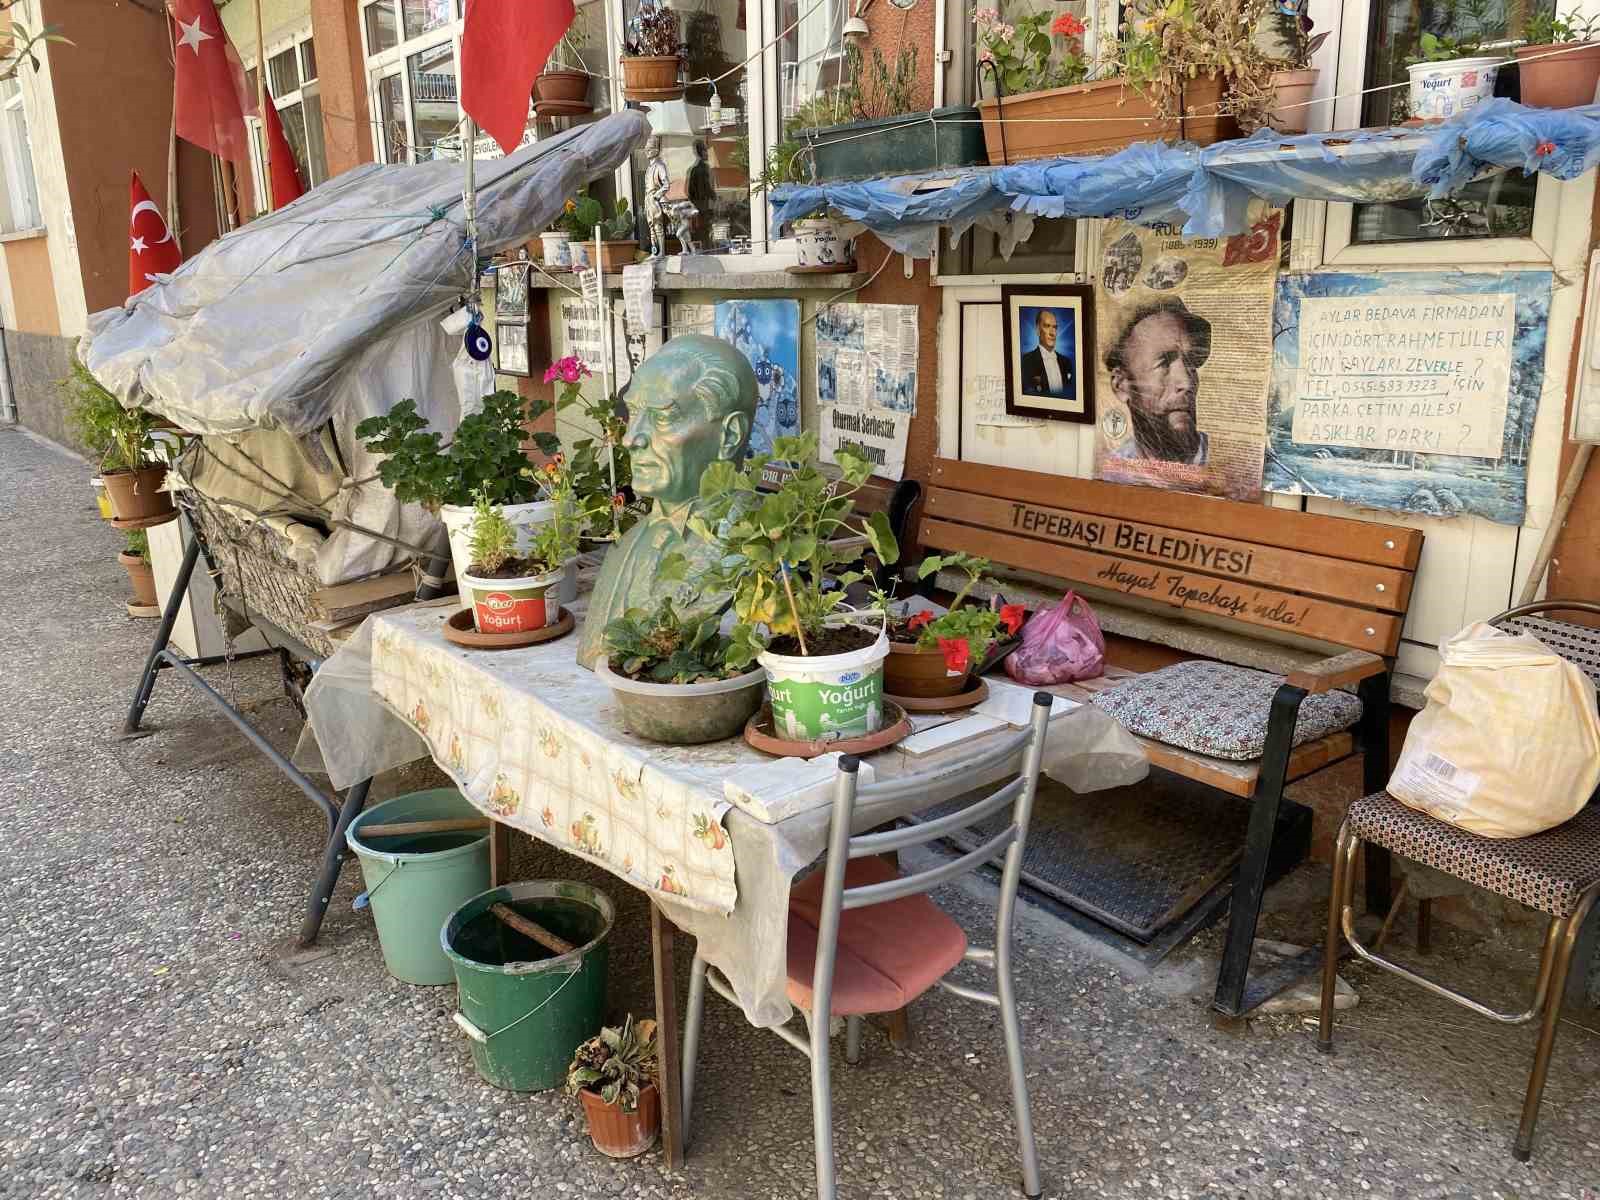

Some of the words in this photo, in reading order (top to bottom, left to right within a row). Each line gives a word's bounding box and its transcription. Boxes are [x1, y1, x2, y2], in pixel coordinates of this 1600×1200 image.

[832, 409, 861, 433] Oturmak
[1012, 503, 1105, 547] TEPEBAŞI
[1114, 524, 1254, 576] BELEDİYESİ
[1097, 561, 1160, 593] Hayat
[818, 680, 875, 706] Yoğurt
